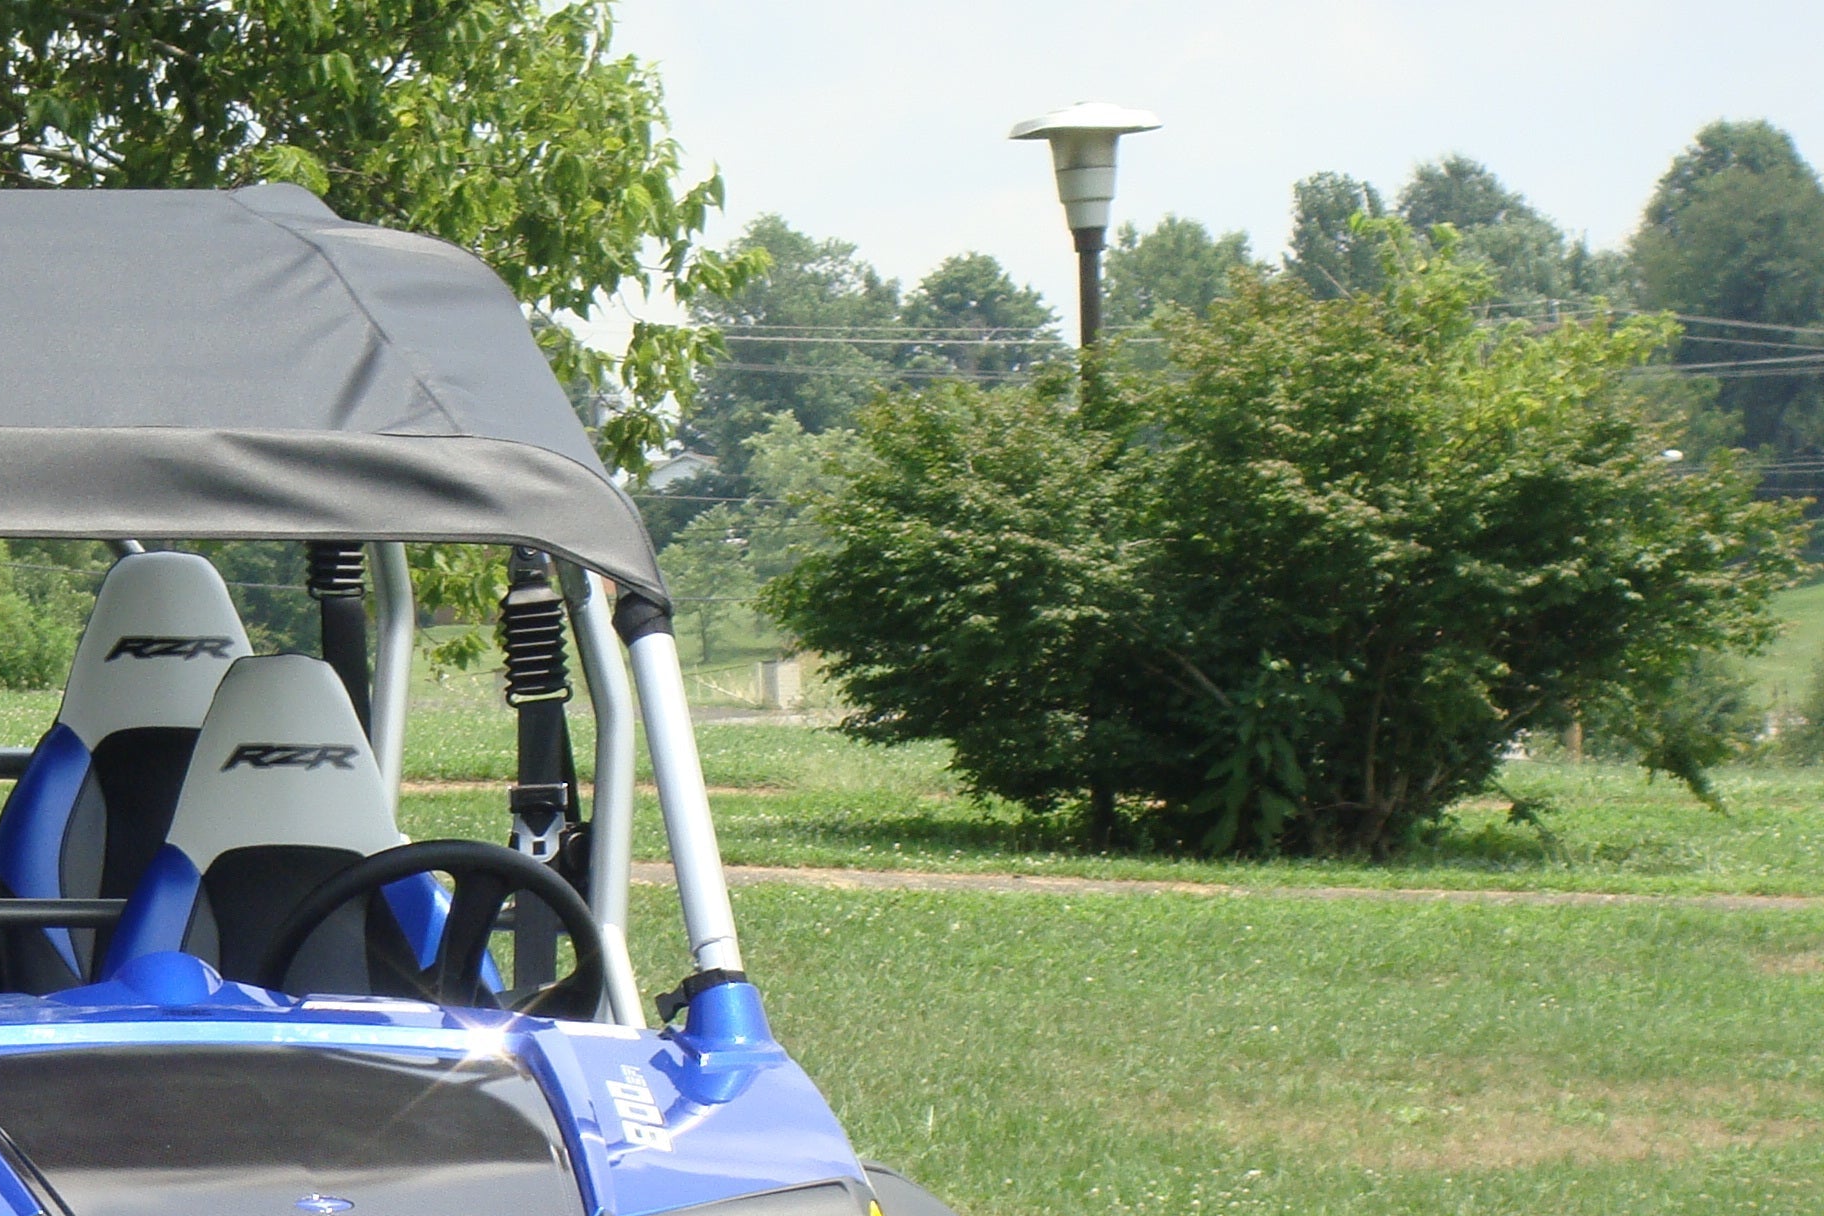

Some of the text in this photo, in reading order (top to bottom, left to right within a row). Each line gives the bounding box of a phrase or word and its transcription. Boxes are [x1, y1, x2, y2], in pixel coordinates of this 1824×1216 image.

[104, 635, 235, 662] RZR
[221, 743, 360, 772] RZR
[605, 1080, 673, 1153] 800
